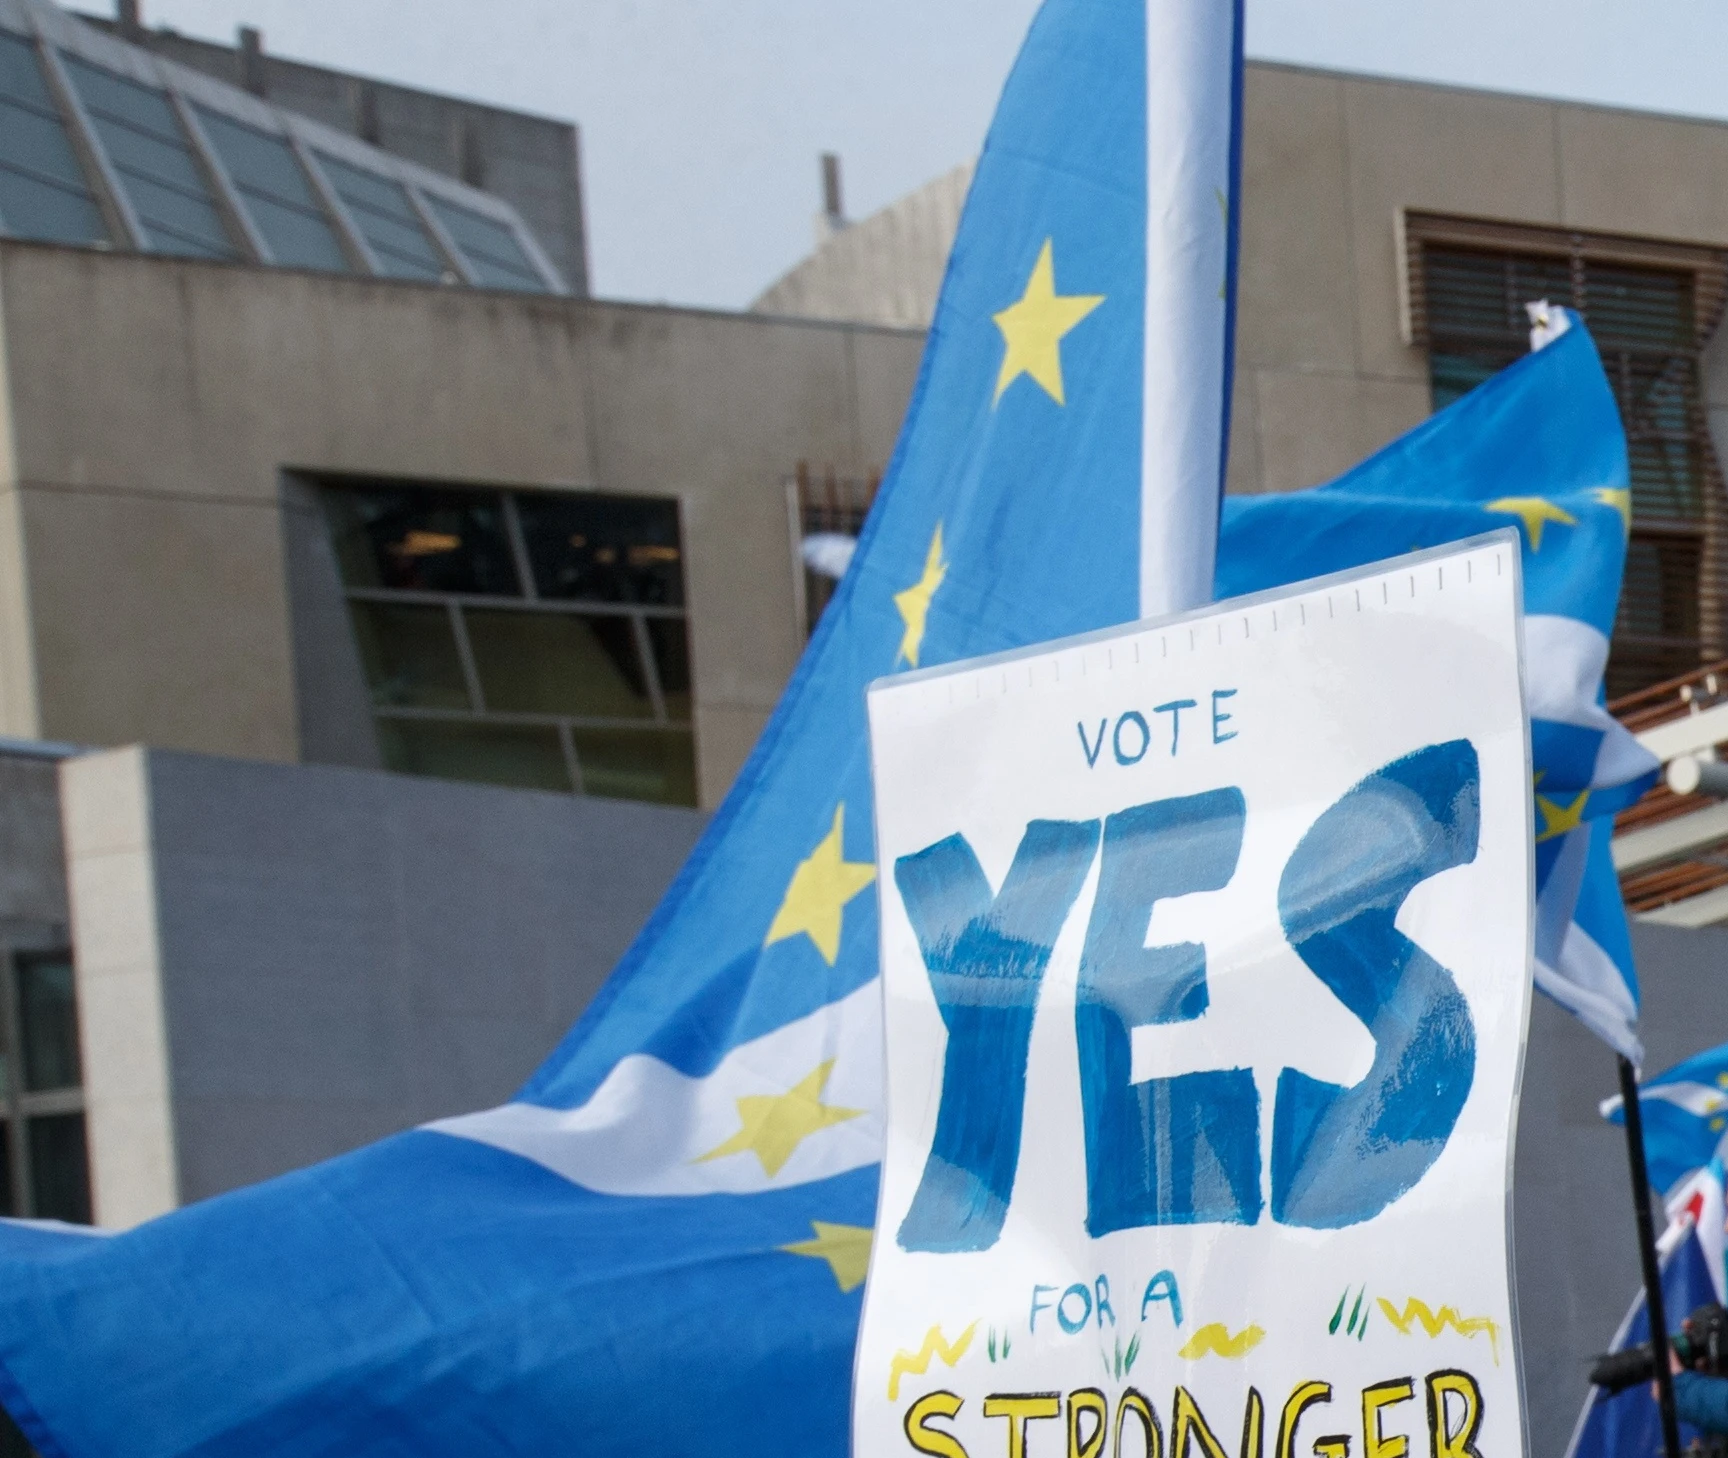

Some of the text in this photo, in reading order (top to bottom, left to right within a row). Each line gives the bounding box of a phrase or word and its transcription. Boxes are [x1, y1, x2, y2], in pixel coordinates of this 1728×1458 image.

[1076, 688, 1239, 769] VOTE
[893, 737, 1481, 1254] YES
[1029, 1269, 1184, 1335] FOR A
